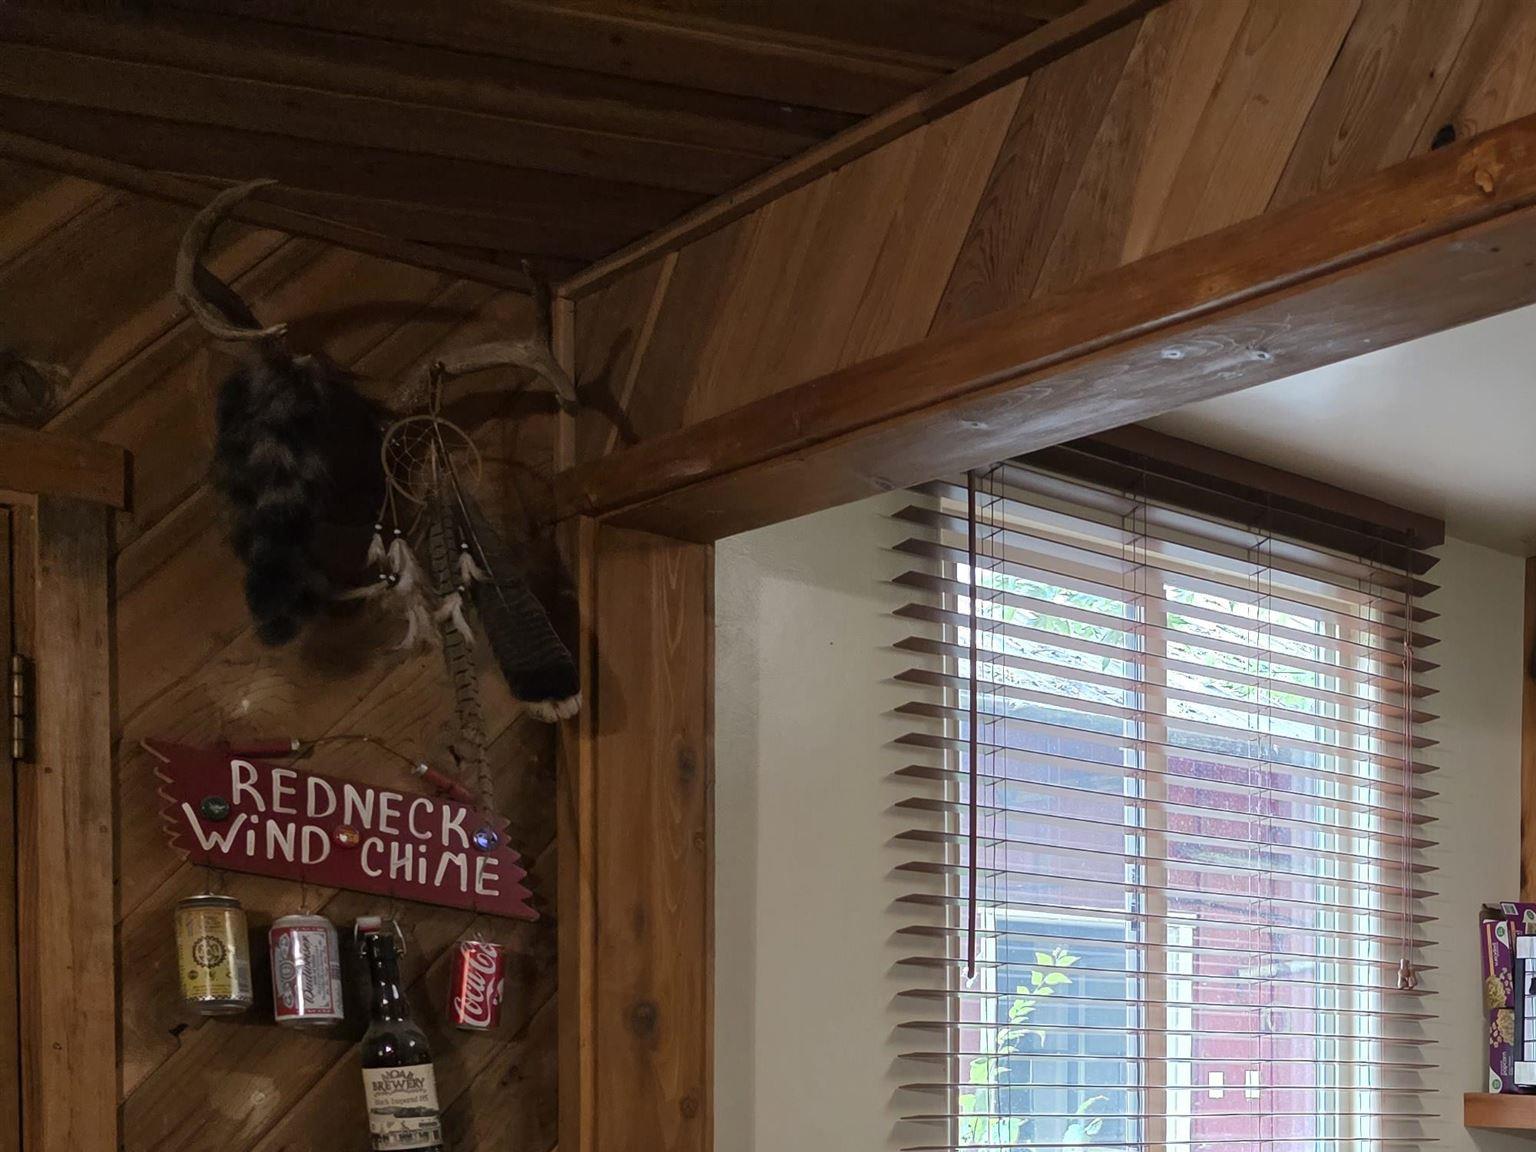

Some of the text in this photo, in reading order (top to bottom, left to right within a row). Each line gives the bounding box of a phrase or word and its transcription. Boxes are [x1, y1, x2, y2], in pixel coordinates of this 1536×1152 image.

[230, 759, 470, 849] REDNECK
[302, 934, 314, 1005] Budweiser
[372, 1077, 426, 1093] BREWERY
